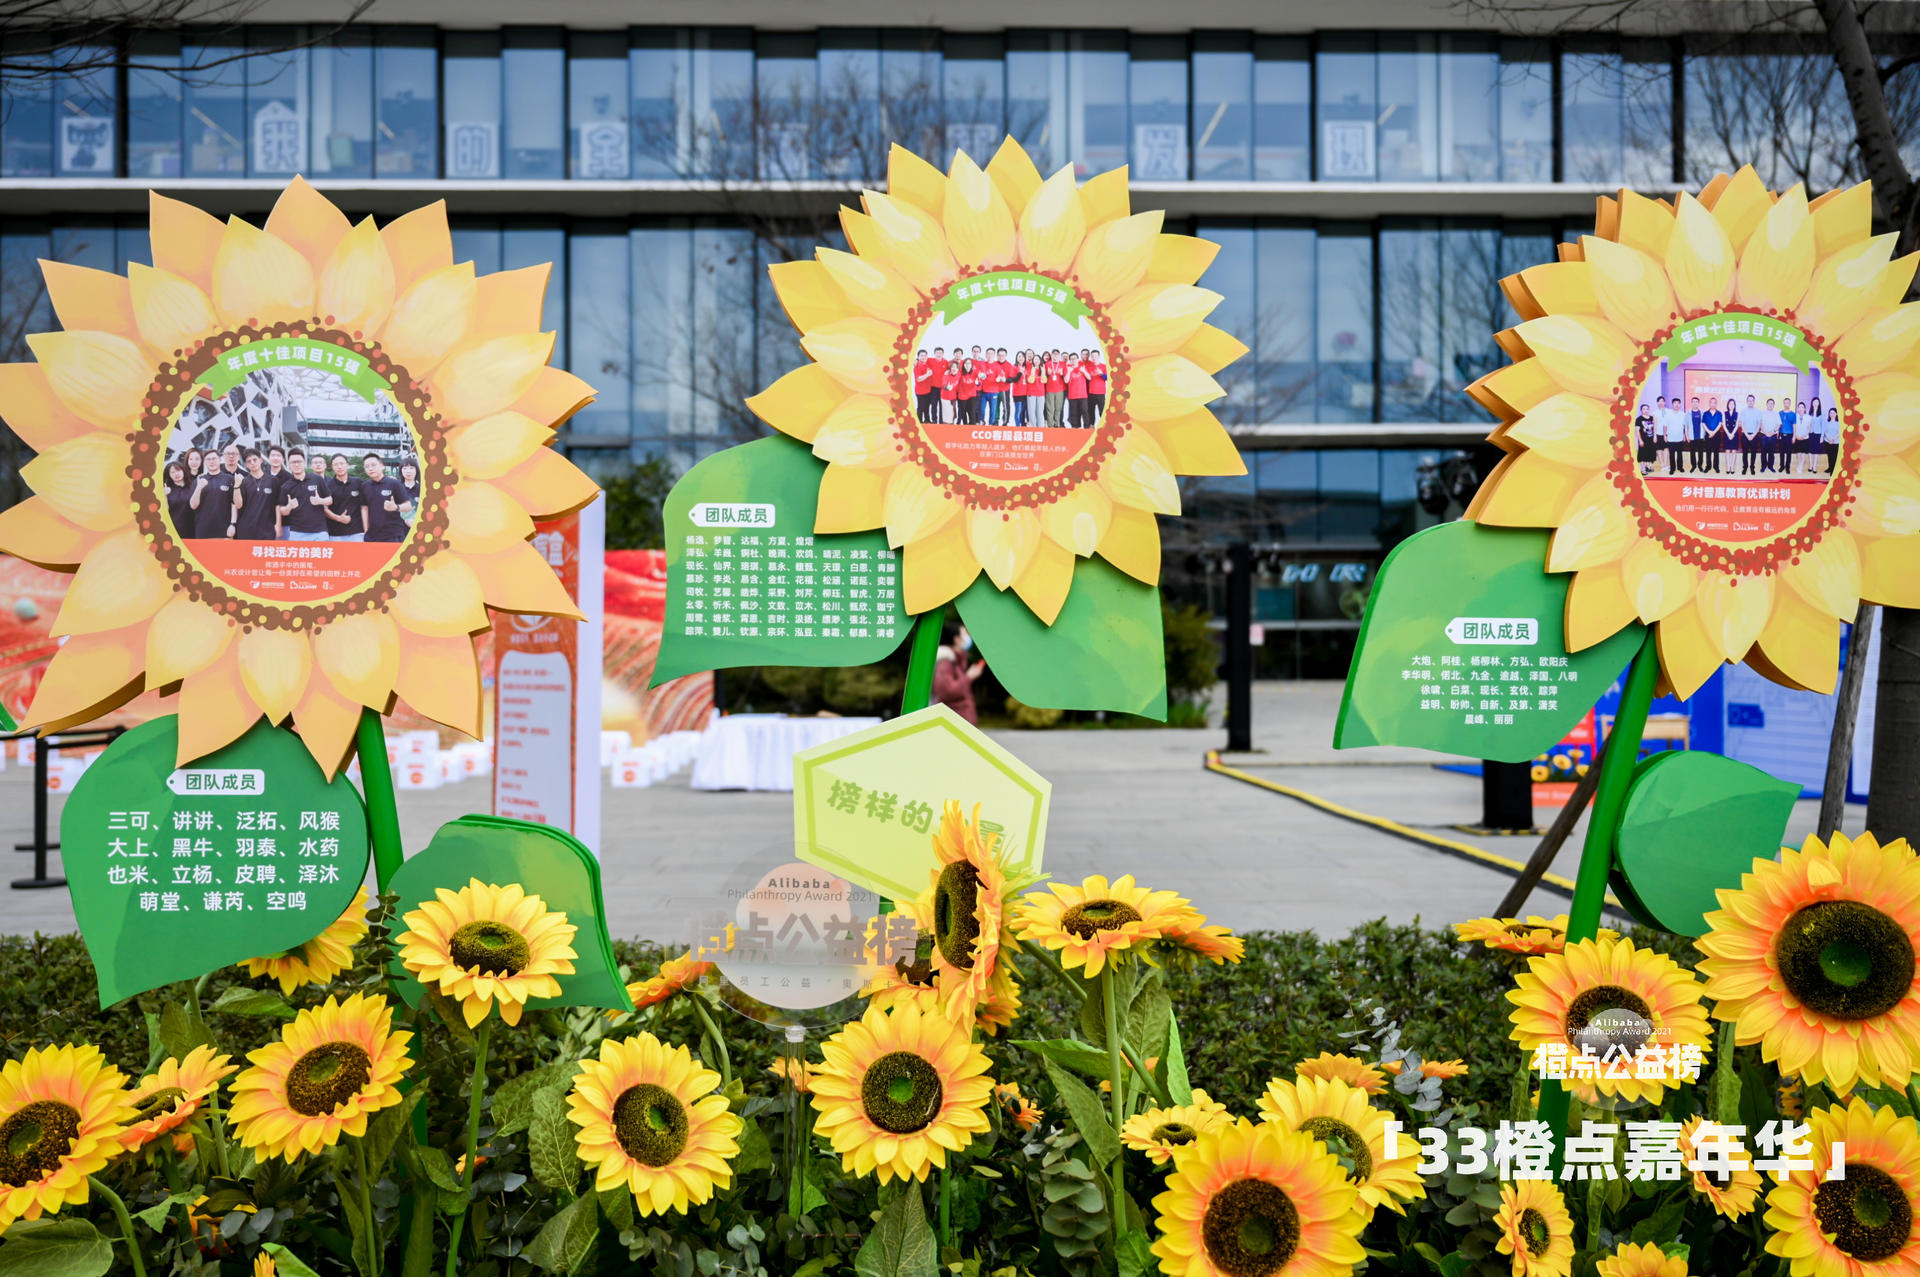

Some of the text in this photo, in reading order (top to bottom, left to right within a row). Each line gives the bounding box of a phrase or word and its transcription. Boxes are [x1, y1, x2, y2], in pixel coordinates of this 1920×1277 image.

[957, 277, 1068, 305] 年度十佳项目15强
[1680, 320, 1797, 348] 年度十佳项目15强
[227, 345, 361, 376] 年度十佳项目15强
[1681, 486, 1791, 500] 乡村普惠教育优课计划
[705, 507, 768, 524] 团队成员
[251, 545, 334, 559] 寻找远方的美好
[1463, 622, 1530, 640] 团队成员
[1464, 714, 1514, 725] 晨峰、丽丽
[186, 773, 256, 791] 团队成员
[107, 811, 341, 832] 三可、讲讲、泛拓、风猴
[107, 837, 340, 858] 大上、黑牛、羽泰、水药
[107, 864, 340, 885] 也米、立杨、皮聘、泽沐
[768, 878, 831, 889] Alibaba
[139, 891, 308, 911] 萌堂、谦芮、空鸣
[727, 888, 873, 903] Philanthropy Award 2021
